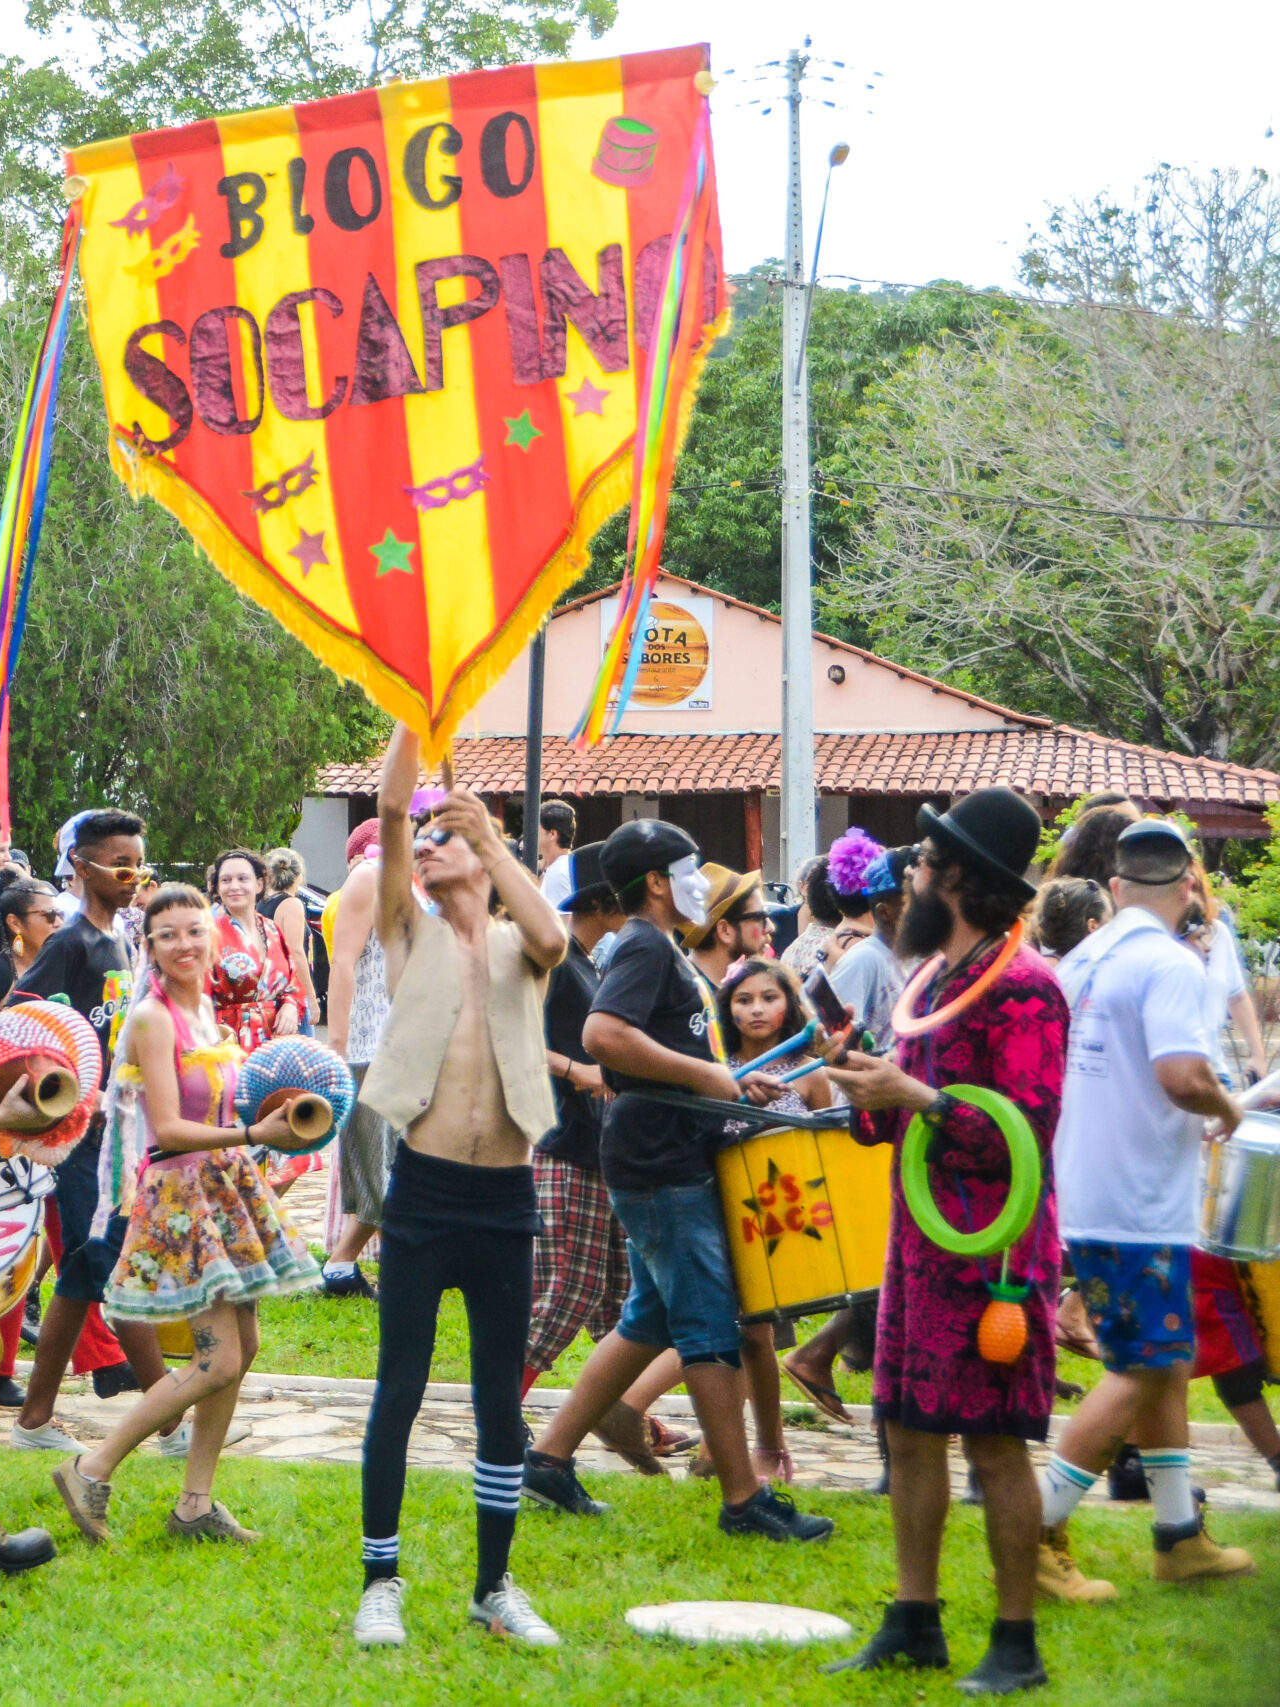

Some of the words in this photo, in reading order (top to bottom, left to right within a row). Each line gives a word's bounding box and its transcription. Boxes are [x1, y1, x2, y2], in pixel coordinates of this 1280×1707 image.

[628, 627, 687, 648] OTA
[648, 643, 666, 651] DOS
[621, 652, 691, 665] SBORES
[758, 1173, 801, 1207] OS
